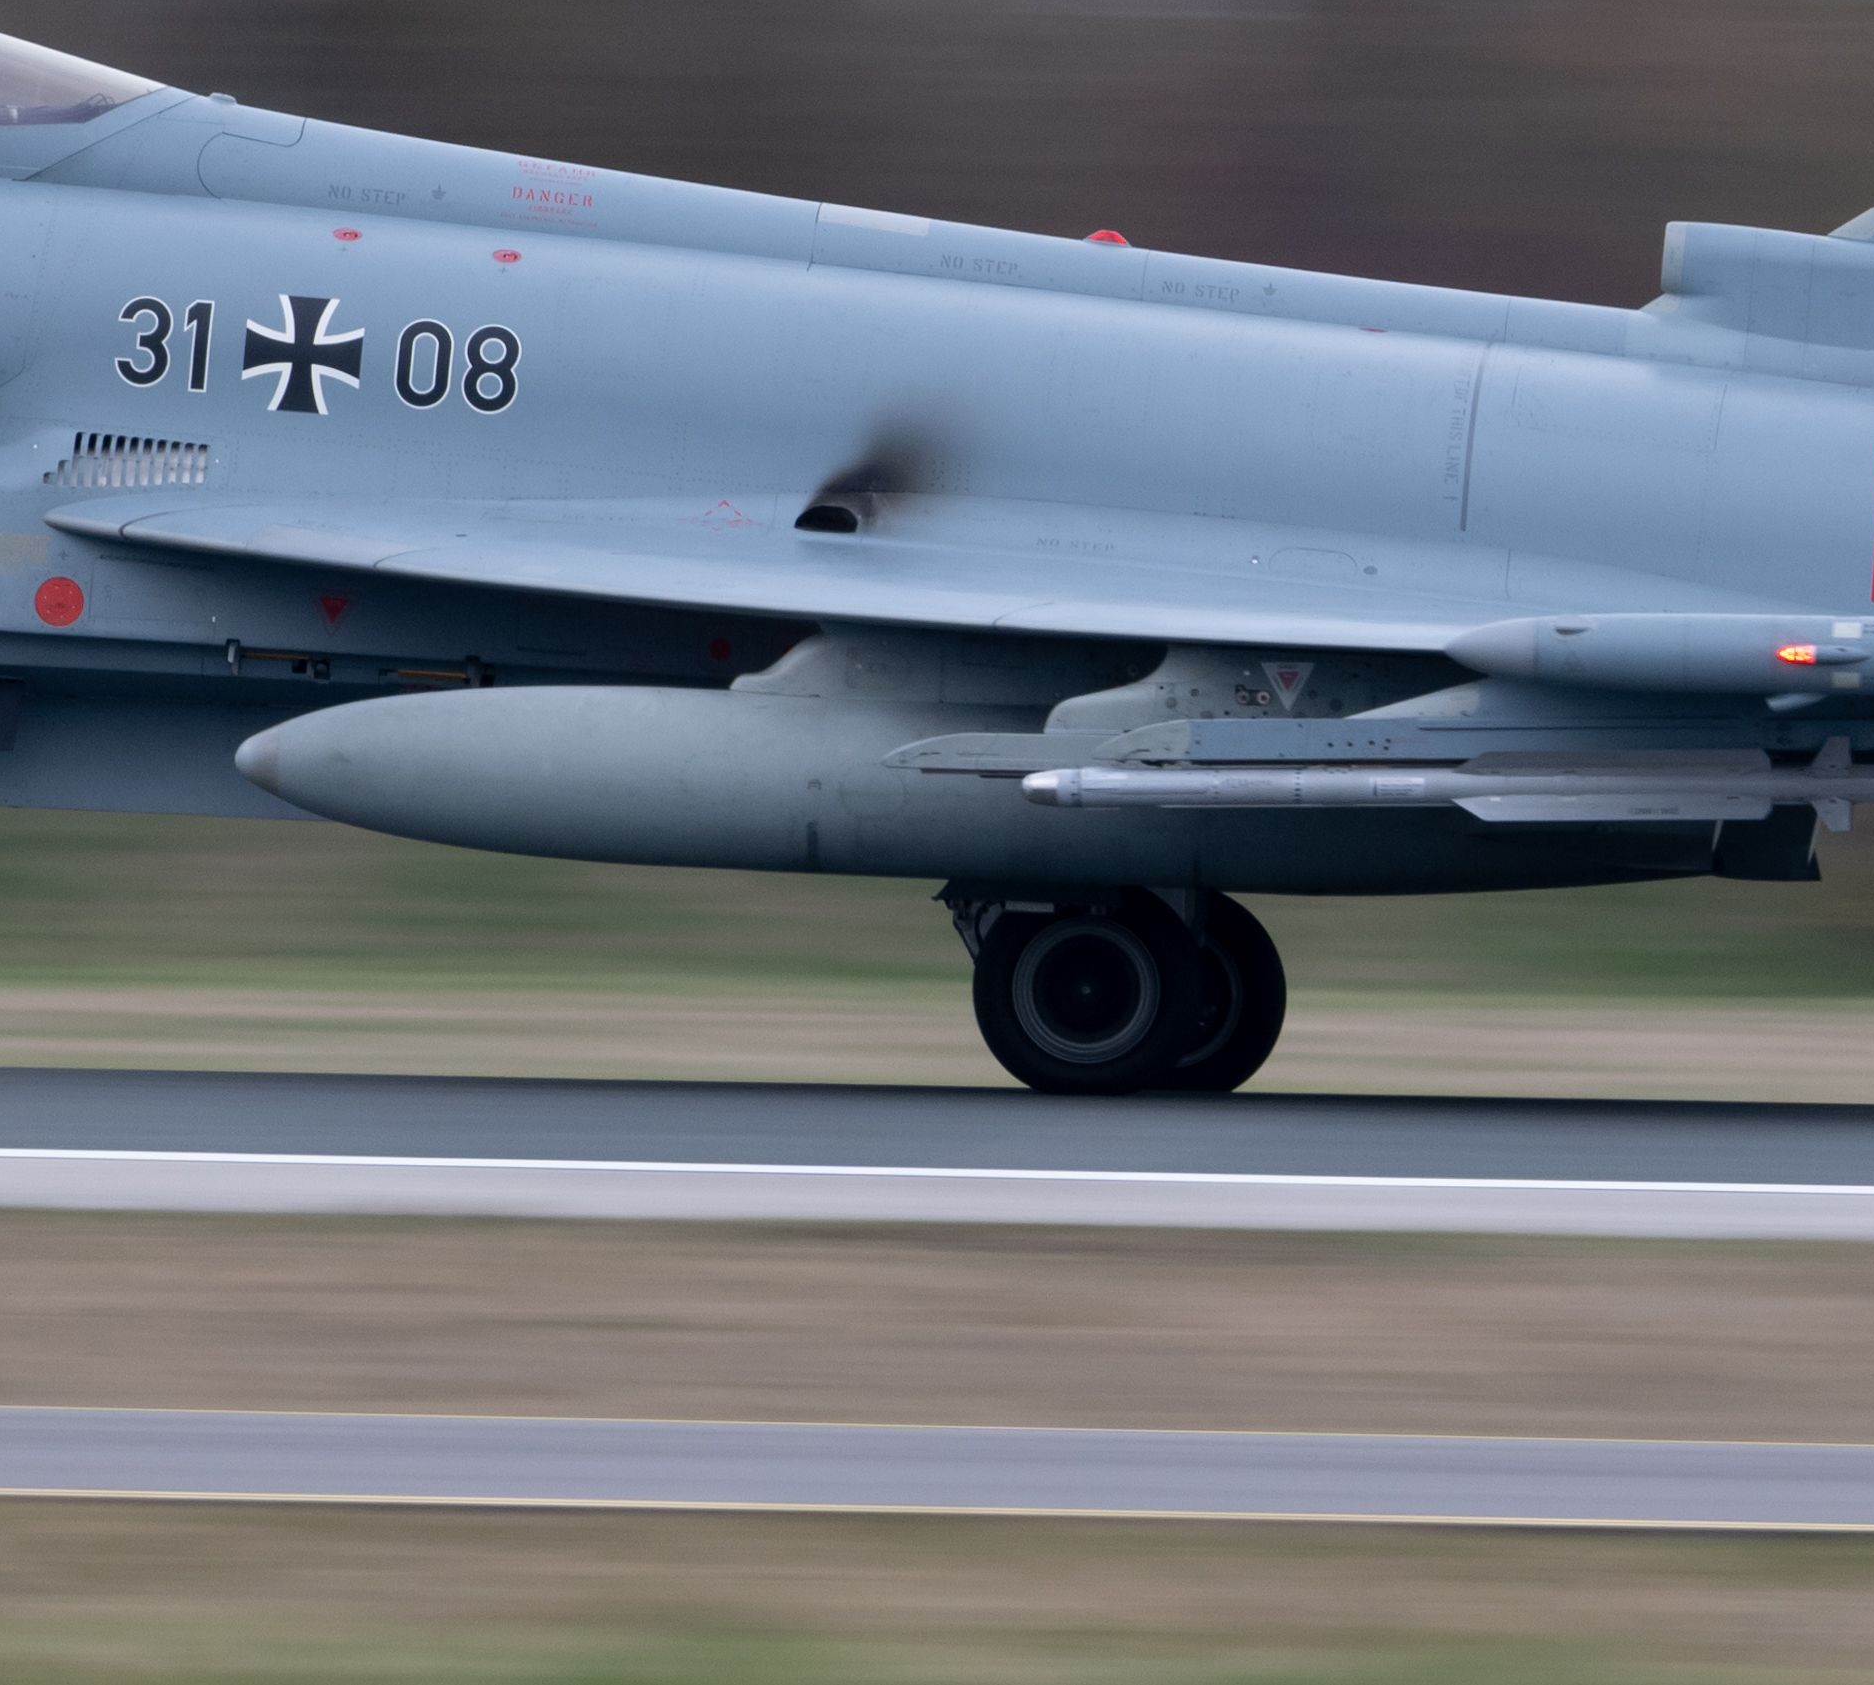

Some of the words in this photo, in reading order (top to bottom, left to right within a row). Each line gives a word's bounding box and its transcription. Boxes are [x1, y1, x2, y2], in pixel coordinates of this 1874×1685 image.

[328, 183, 352, 200] NO
[361, 187, 406, 205] STEP
[511, 185, 593, 208] DANGER
[940, 254, 964, 269] NO
[973, 257, 1019, 275] STEP
[1161, 280, 1186, 294] NO
[1194, 283, 1240, 302] STEP
[114, 296, 215, 393] 31
[393, 318, 522, 415] 08
[1449, 408, 1467, 441] THIS
[1444, 445, 1462, 484] LINE
